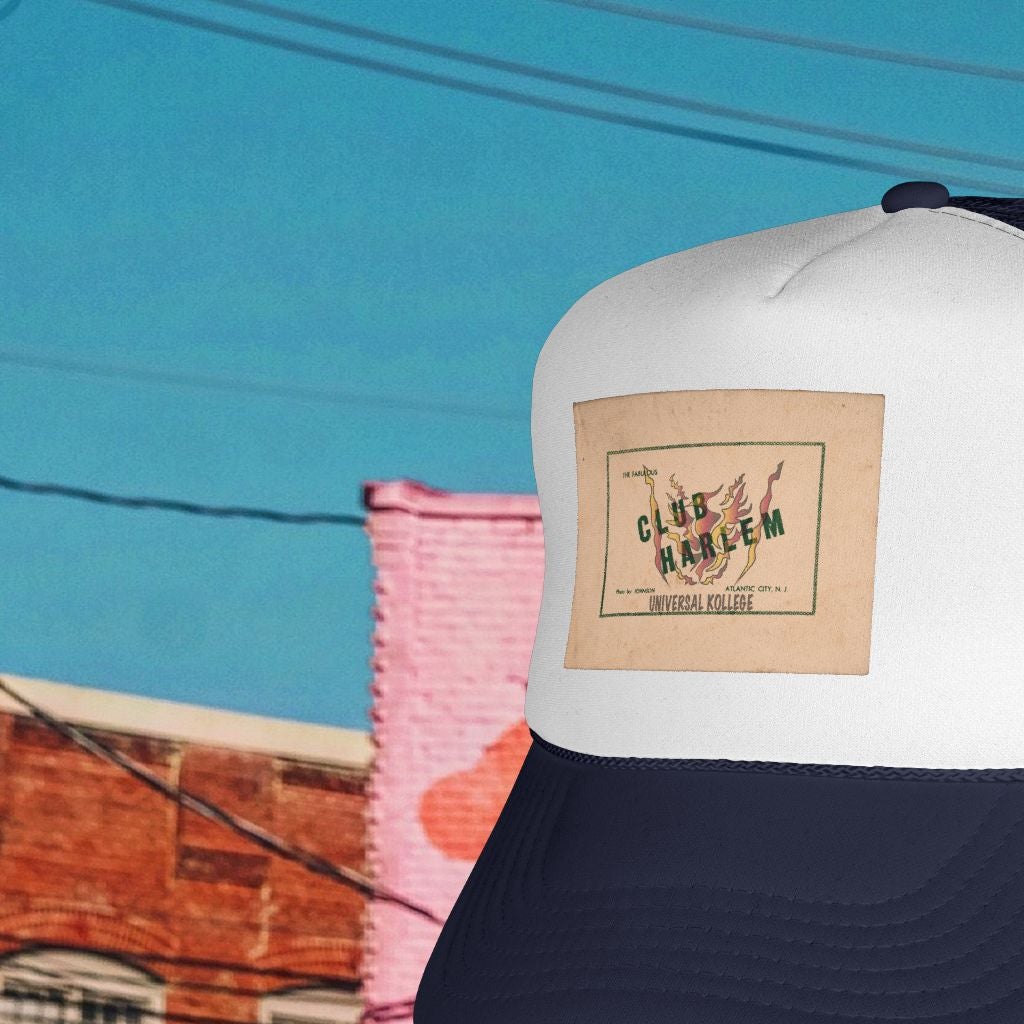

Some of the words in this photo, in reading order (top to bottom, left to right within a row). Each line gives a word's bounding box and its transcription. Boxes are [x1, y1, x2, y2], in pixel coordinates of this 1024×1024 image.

[637, 492, 708, 542] CLUB
[660, 508, 785, 574] HARLEM
[649, 594, 703, 611] UNIVERSAL
[706, 594, 754, 611] KOLLEGE
